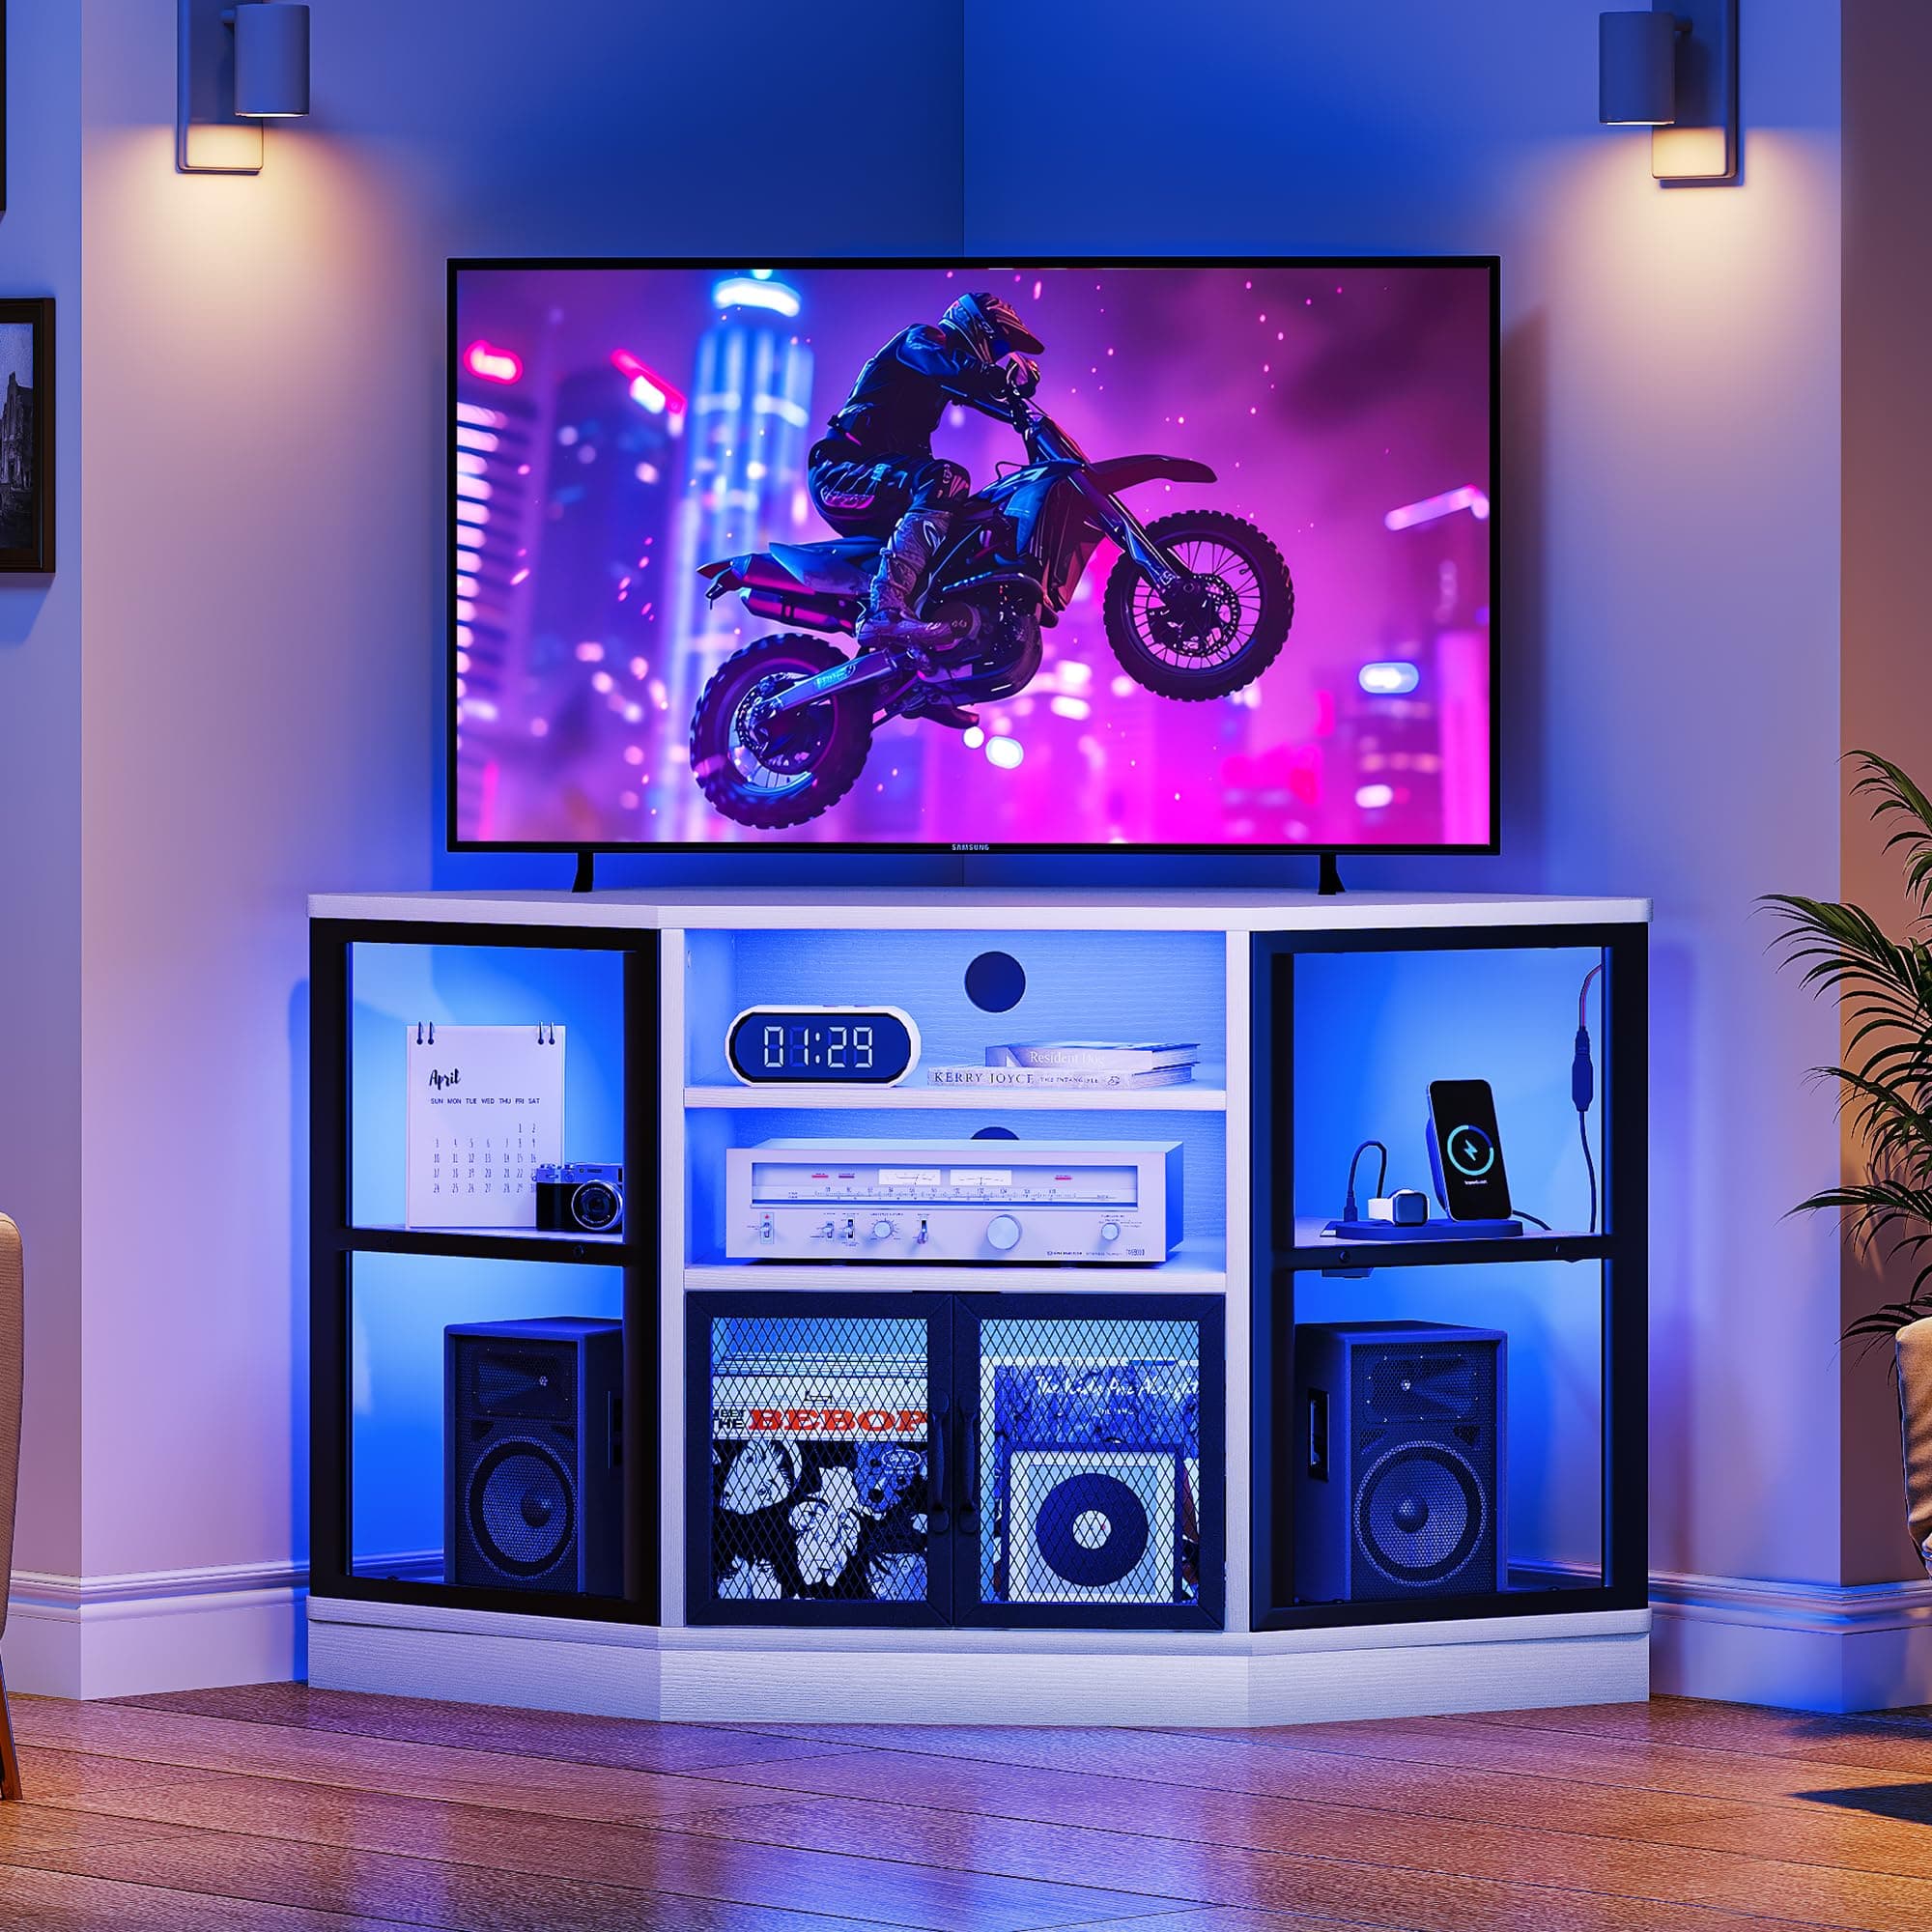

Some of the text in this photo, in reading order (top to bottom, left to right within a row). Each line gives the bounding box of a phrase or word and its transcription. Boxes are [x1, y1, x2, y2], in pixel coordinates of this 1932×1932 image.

[764, 1026, 872, 1067] 01:29
[1030, 1051, 1078, 1064] Resident
[429, 1067, 462, 1091] April
[933, 1071, 983, 1084] KERRY
[989, 1072, 1035, 1085] JOYCE
[749, 1408, 928, 1432] BEBOP
